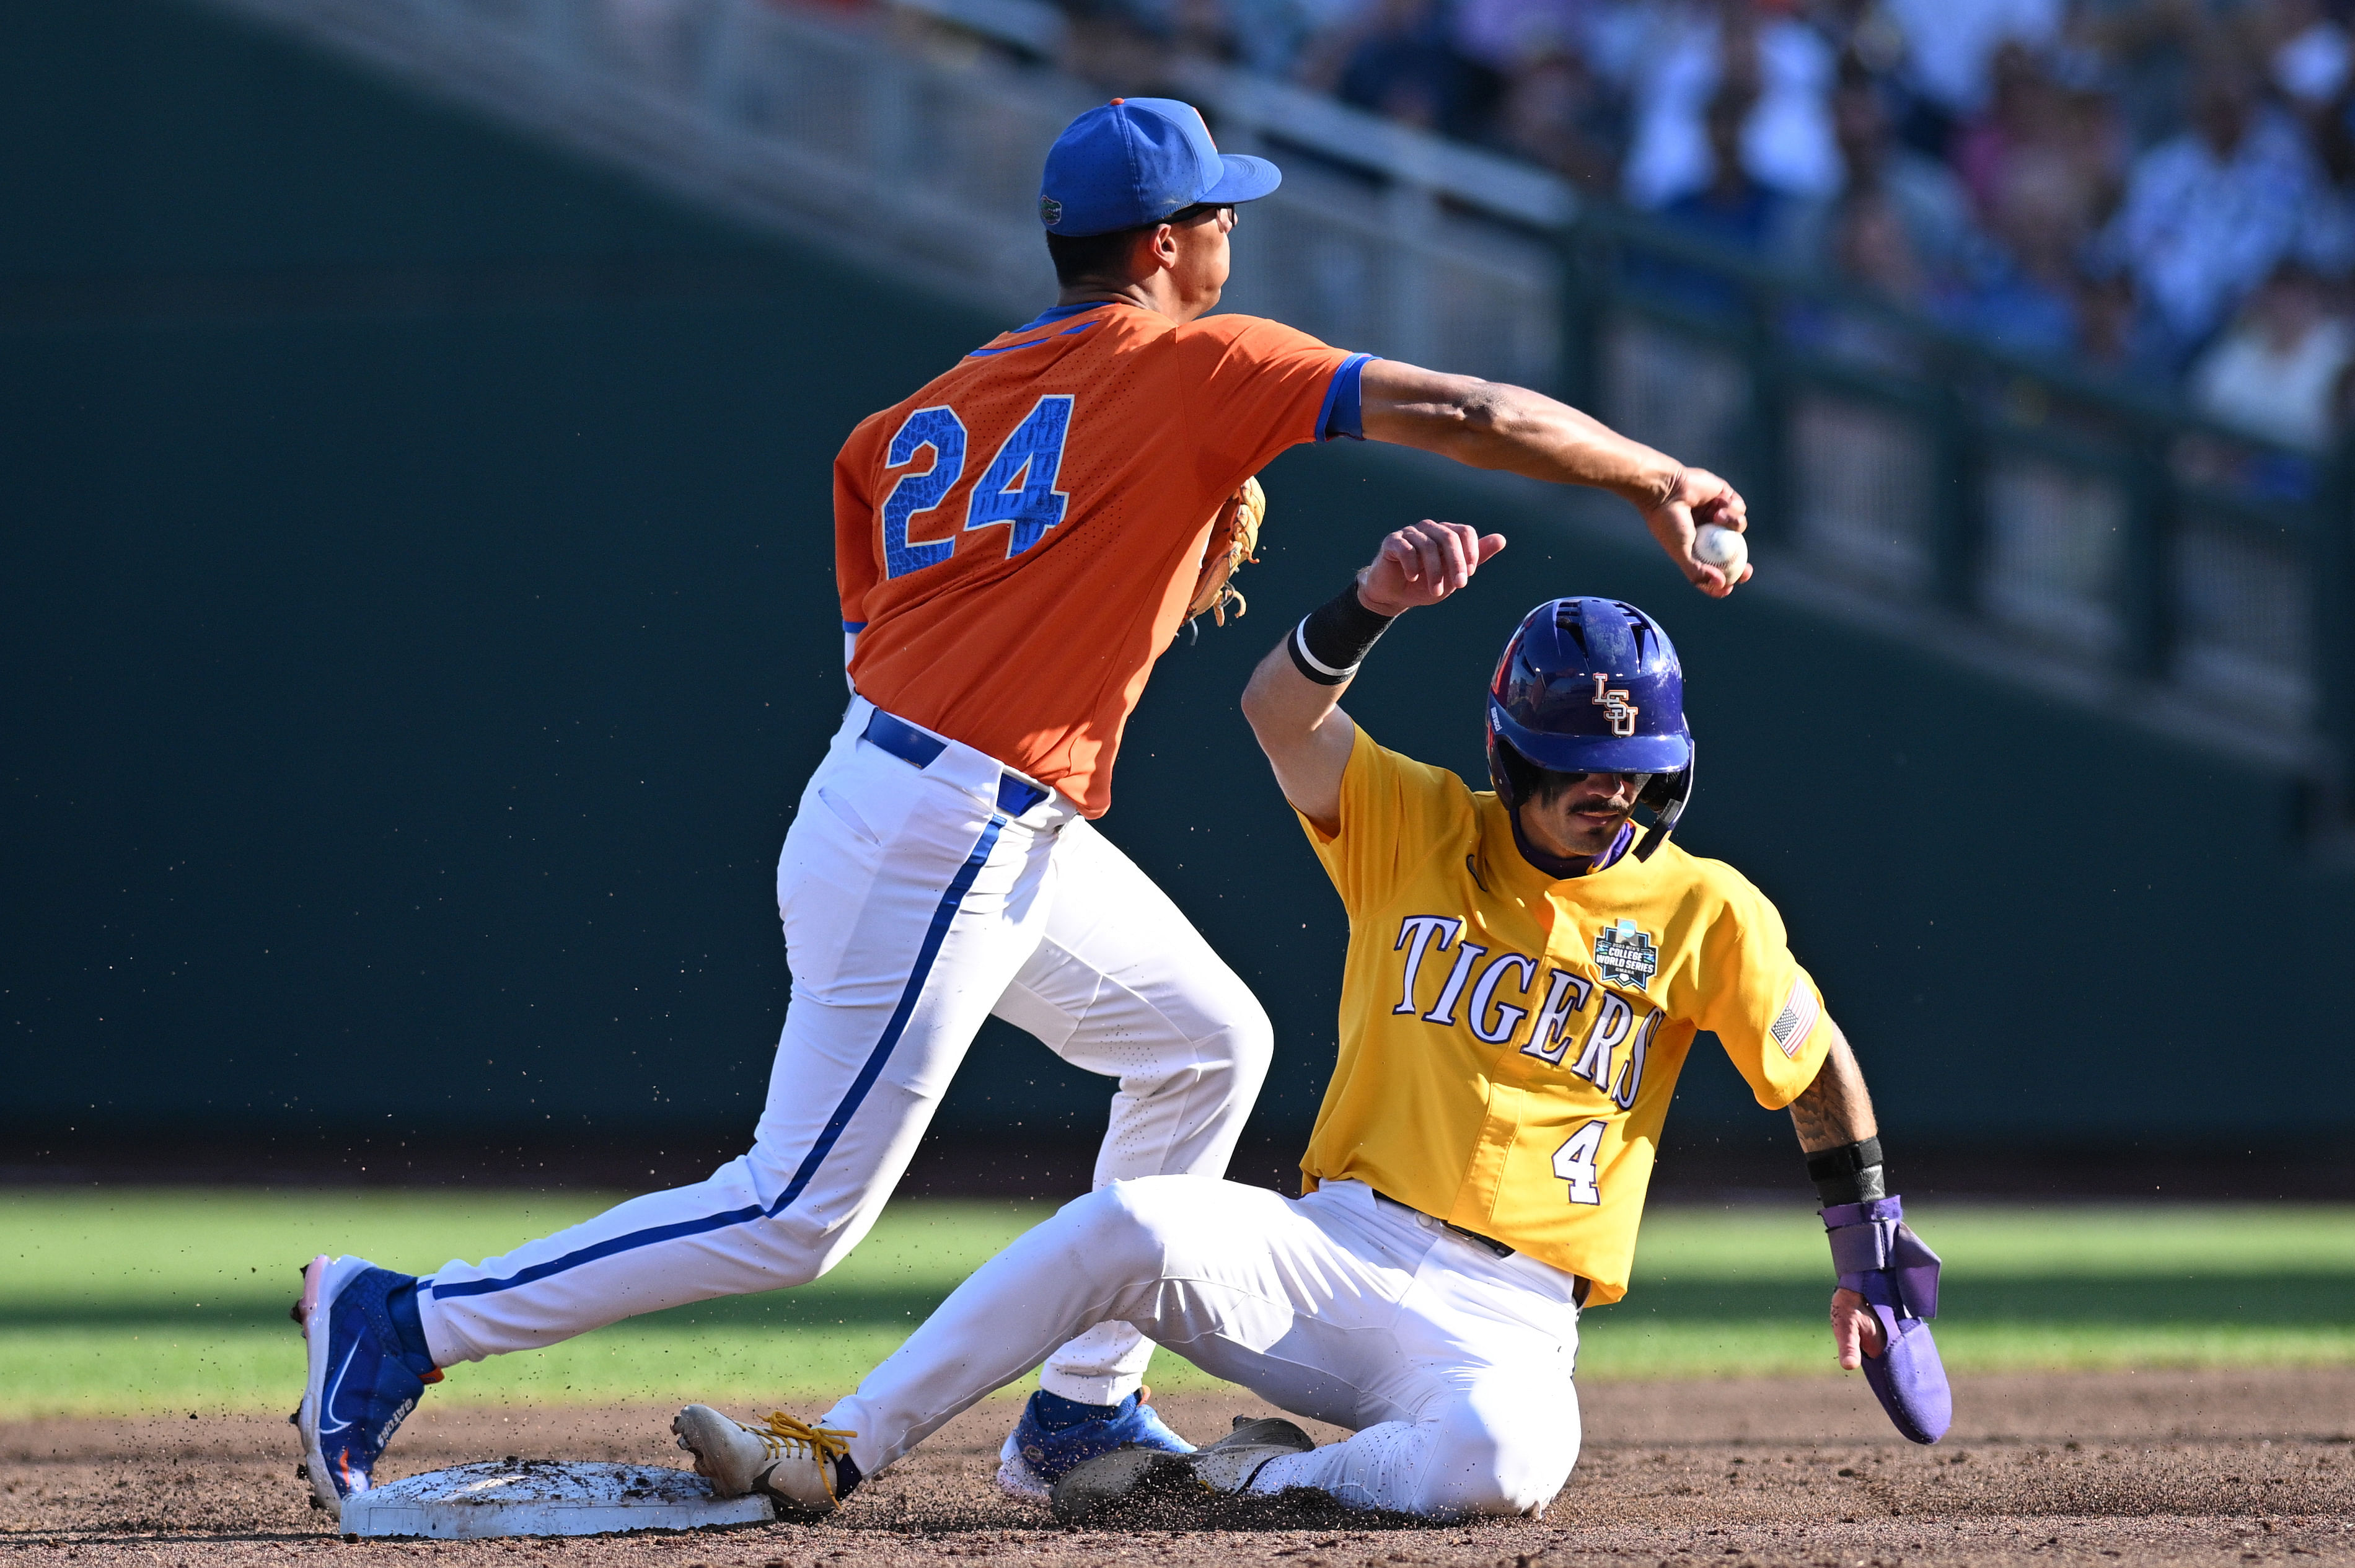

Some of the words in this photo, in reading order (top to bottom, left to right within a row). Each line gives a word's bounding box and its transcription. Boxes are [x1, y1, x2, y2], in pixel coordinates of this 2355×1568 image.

[882, 394, 1075, 580] 24
[1592, 673, 1639, 737] LSU
[1596, 954, 1625, 967] WORLD
[1625, 958, 1654, 973] SERIES
[1608, 947, 1643, 961] COLLEGE
[1615, 967, 1635, 975] OMAHA
[1392, 915, 1666, 1111] TIGERS
[1551, 1120, 1609, 1205] 4
